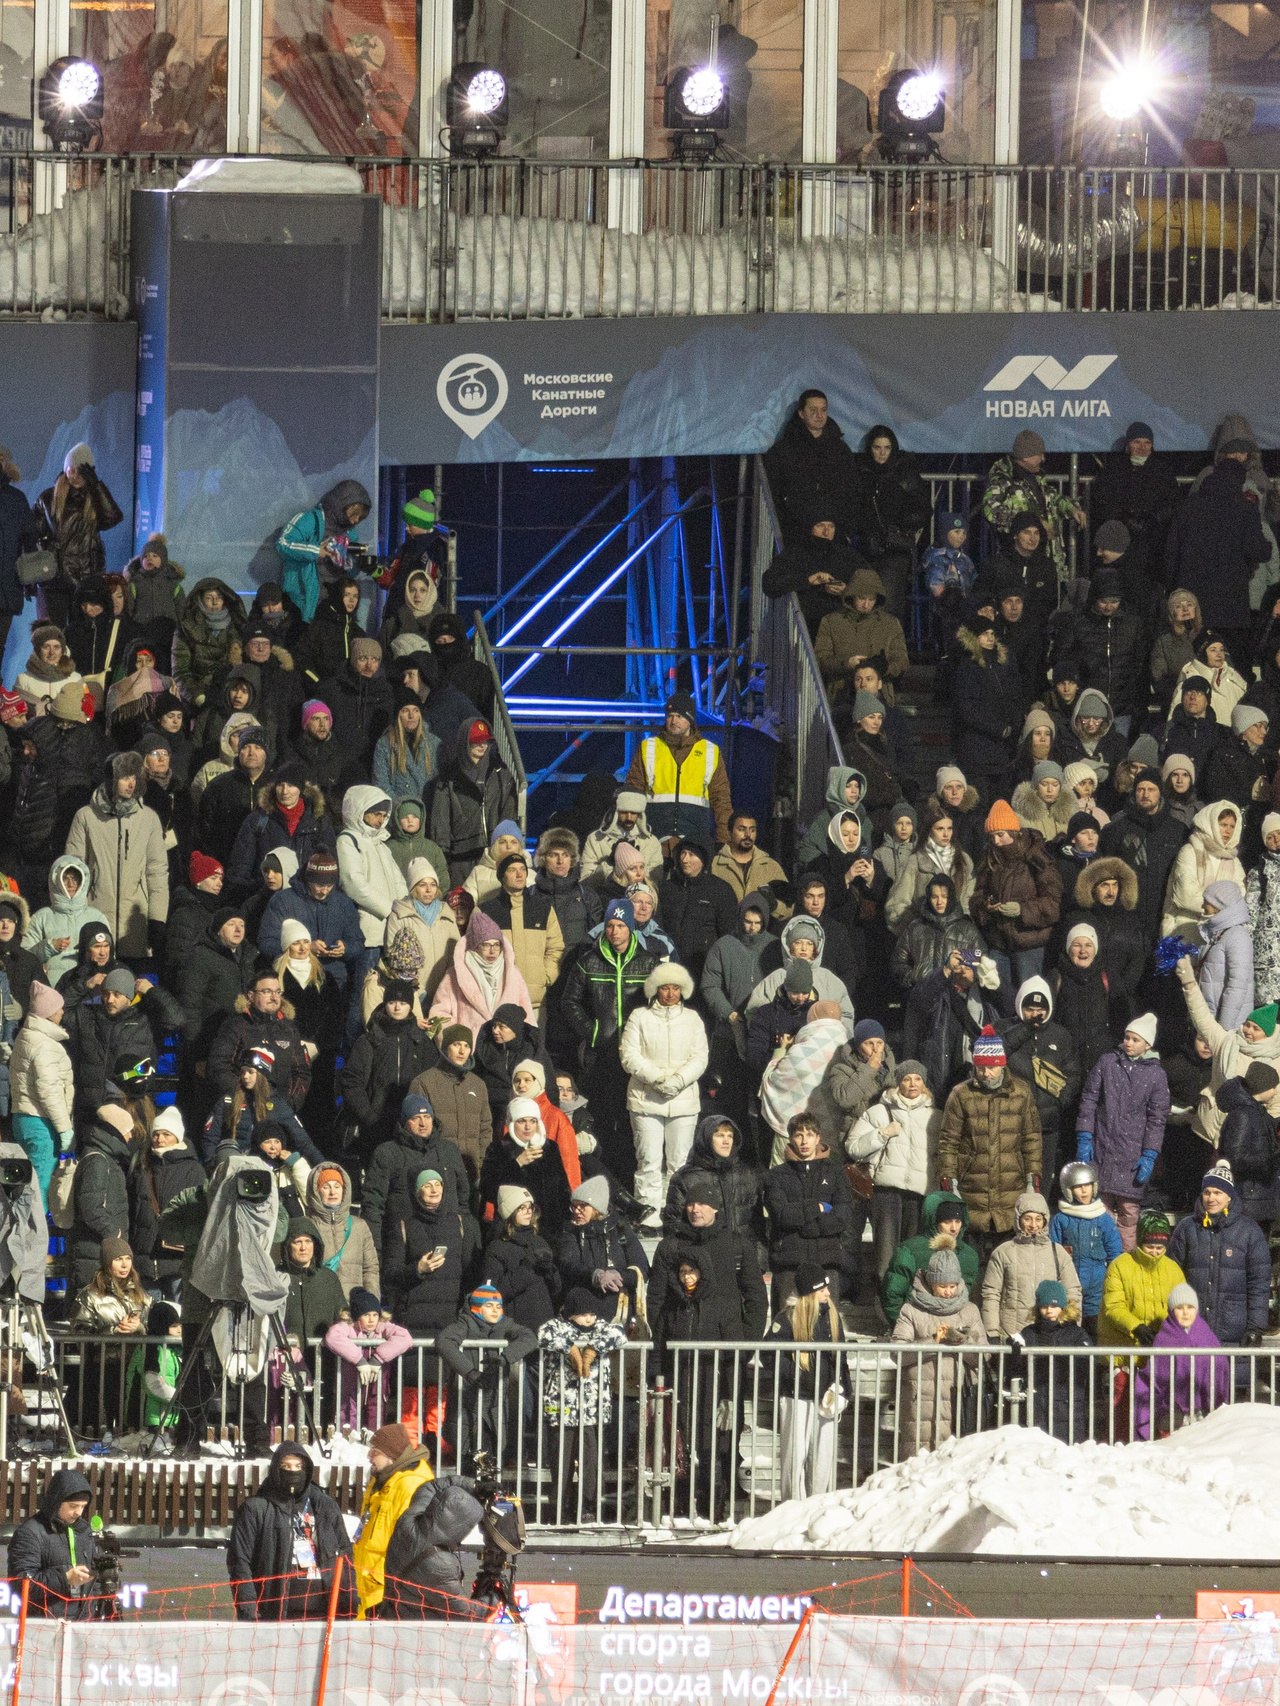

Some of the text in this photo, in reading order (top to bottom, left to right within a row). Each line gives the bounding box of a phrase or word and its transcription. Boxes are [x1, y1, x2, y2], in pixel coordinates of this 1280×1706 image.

[523, 373, 614, 385] Московские
[532, 389, 606, 401] Канатные
[540, 405, 598, 418] Дороги
[986, 400, 1112, 418] НОВАЯ ЛИГА
[600, 1632, 712, 1664] спорта
[600, 1671, 712, 1702] города
